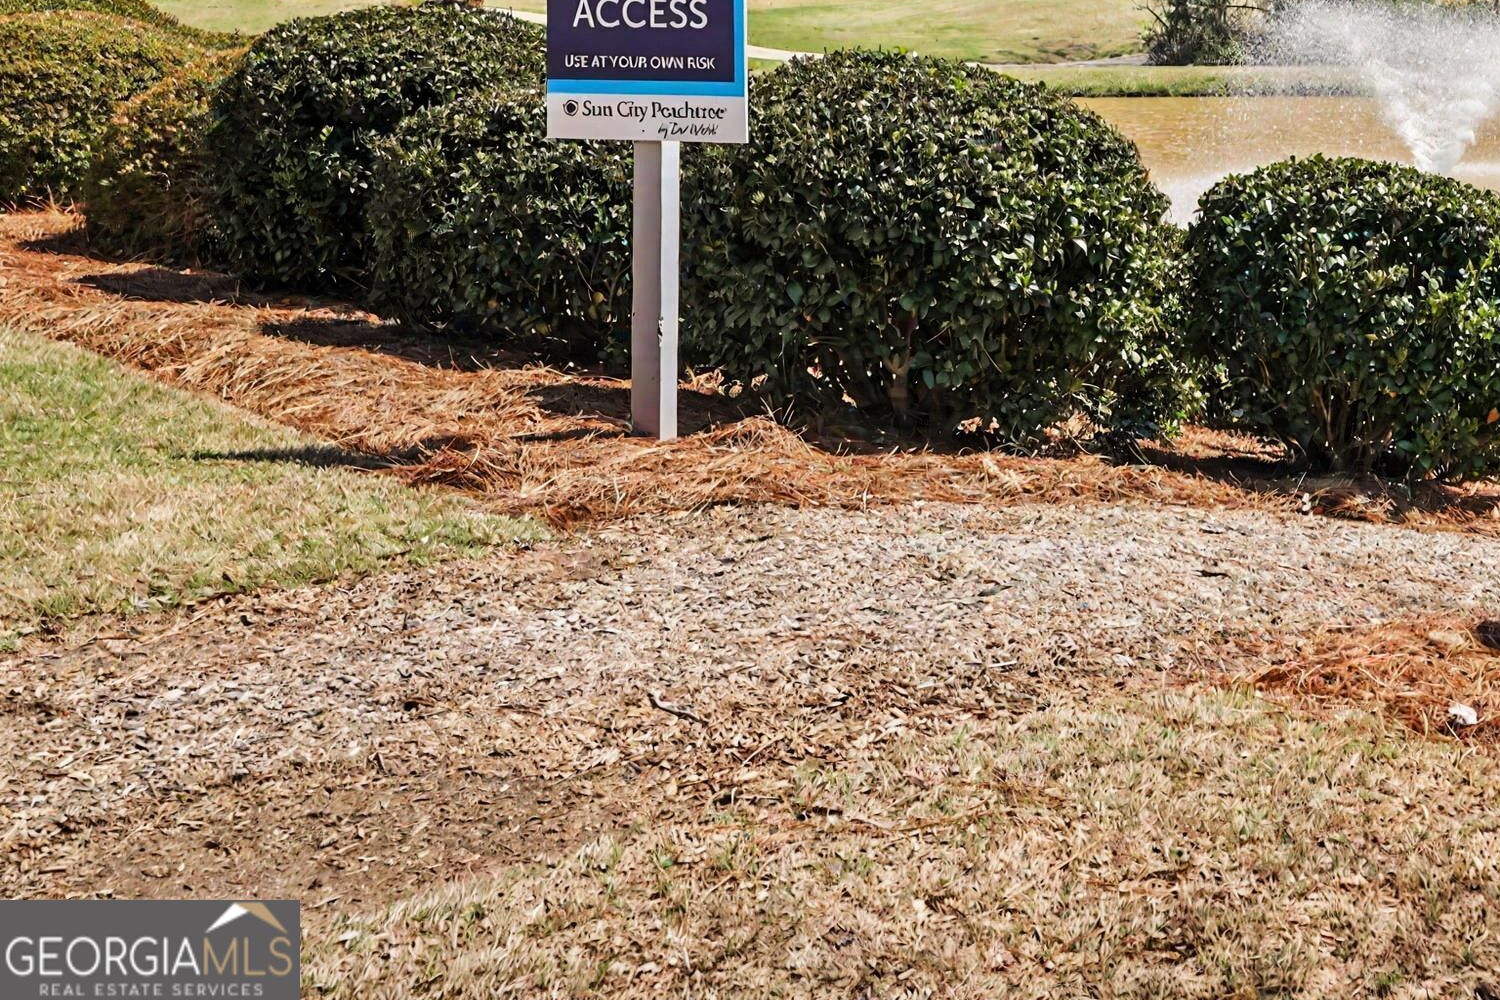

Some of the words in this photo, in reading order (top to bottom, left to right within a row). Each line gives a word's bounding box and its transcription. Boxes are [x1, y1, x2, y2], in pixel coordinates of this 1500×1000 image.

[565, 55, 588, 68] USE
[591, 55, 607, 68] AT
[609, 56, 647, 69] YOUR
[651, 56, 684, 69] OWN
[687, 57, 716, 70] RISK
[582, 100, 613, 117] Sun
[617, 100, 648, 122] City
[651, 101, 725, 119] Peachtree
